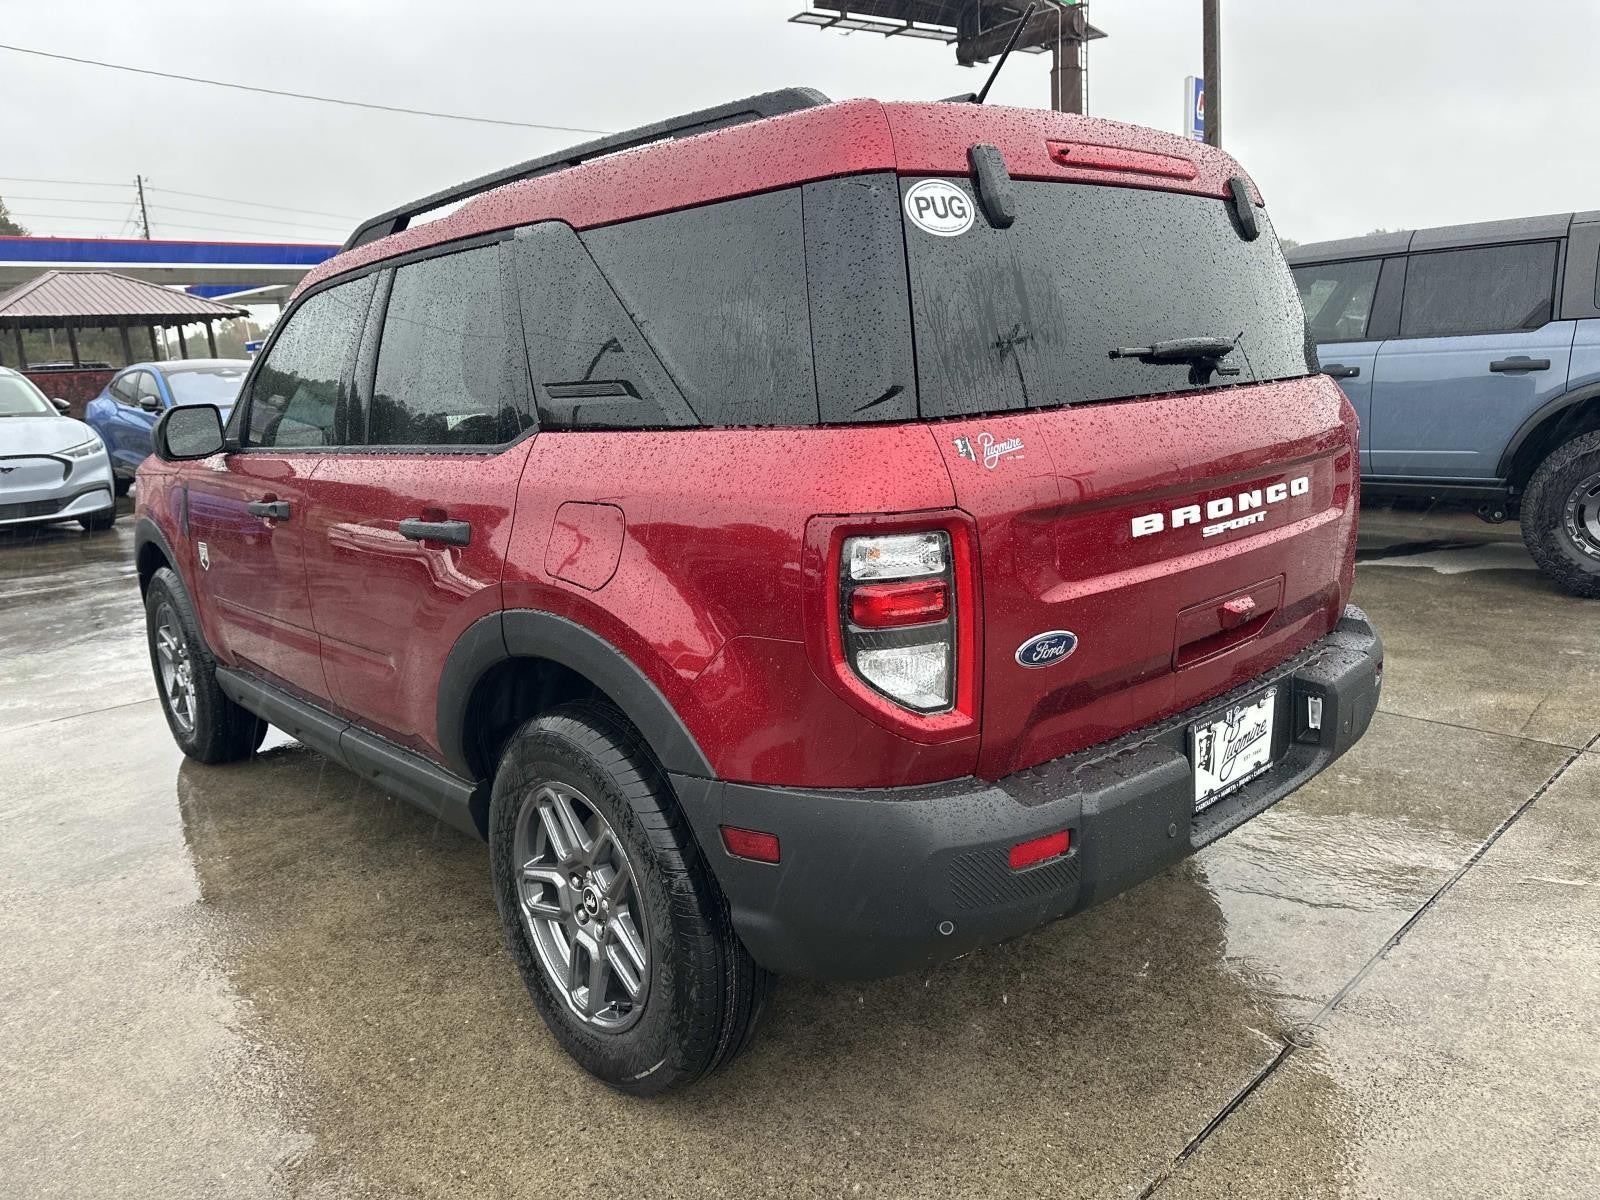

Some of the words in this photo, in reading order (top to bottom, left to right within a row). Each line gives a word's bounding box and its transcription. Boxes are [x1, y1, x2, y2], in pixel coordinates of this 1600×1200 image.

[914, 195, 967, 219] PUG
[977, 432, 1024, 469] Pugmire
[1131, 476, 1309, 538] BRONCO
[1202, 510, 1268, 538] SPORT
[1032, 638, 1067, 661] Ford
[1219, 719, 1267, 782] Pugmire
